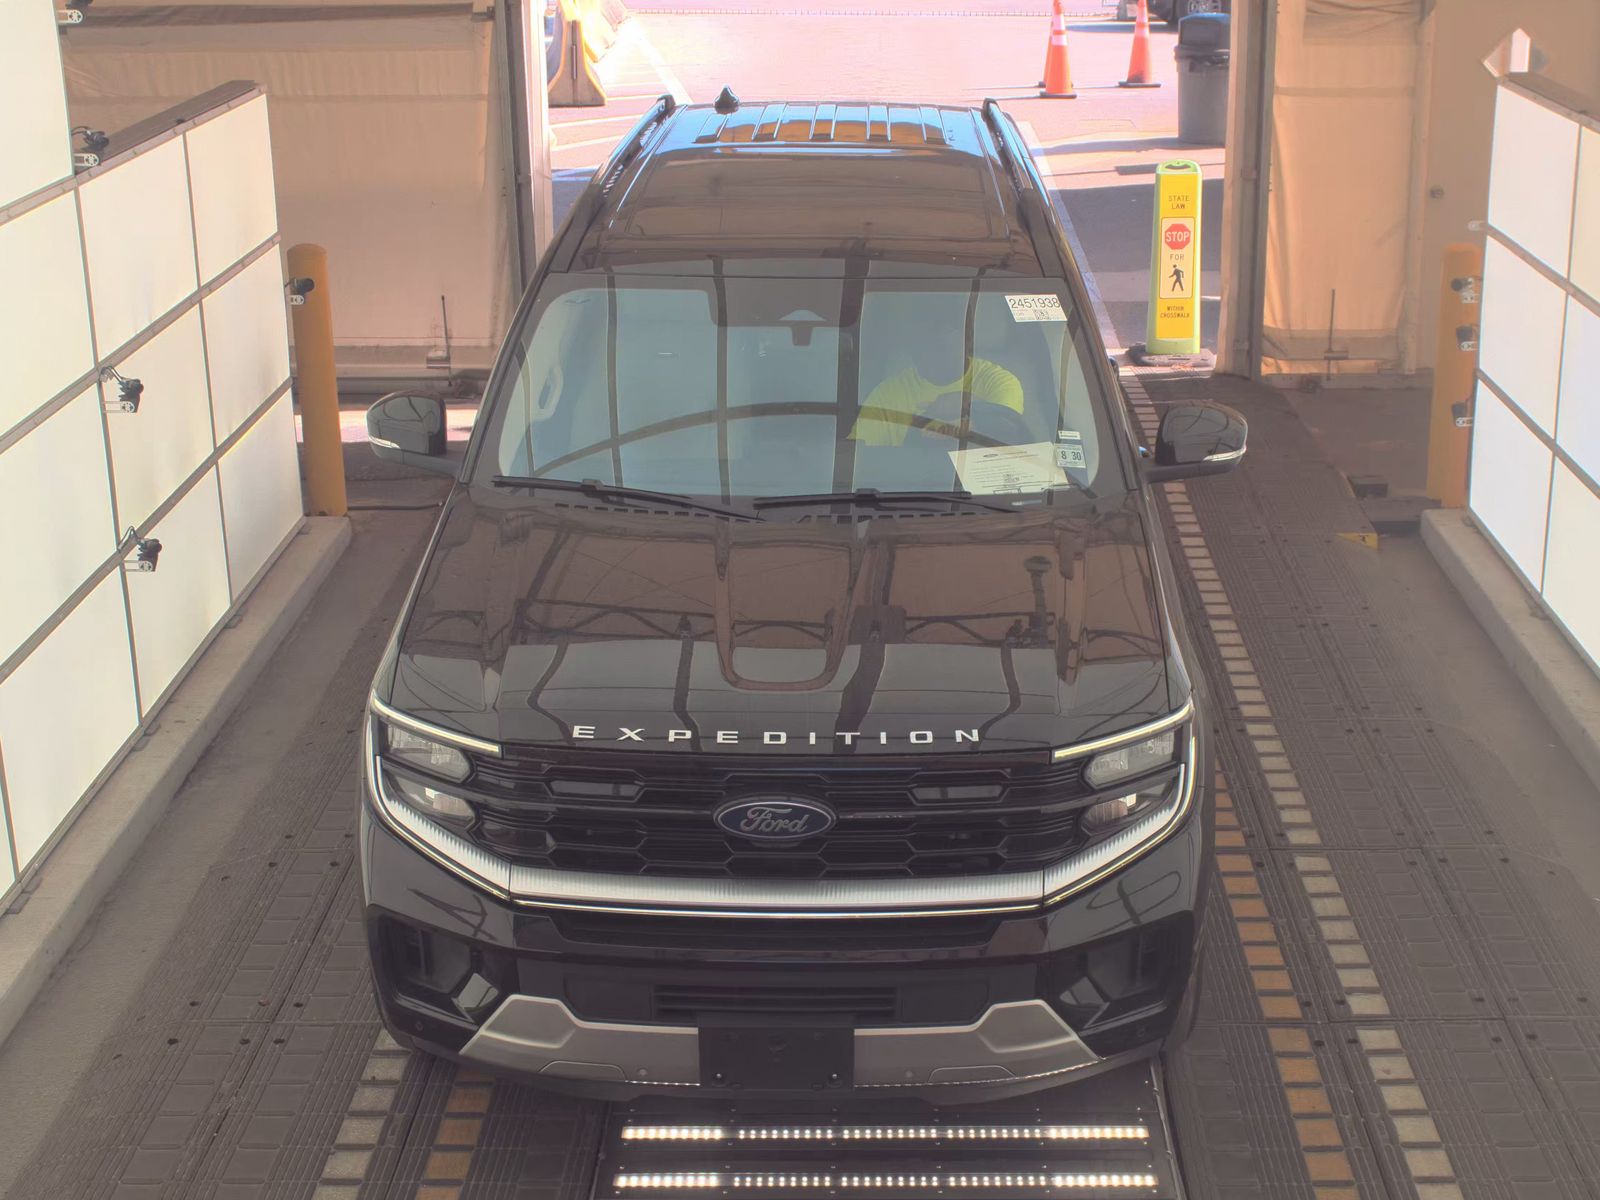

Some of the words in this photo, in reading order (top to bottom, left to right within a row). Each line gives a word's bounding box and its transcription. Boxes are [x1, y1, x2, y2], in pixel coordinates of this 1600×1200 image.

[1166, 231, 1190, 242] STOP
[1009, 297, 1061, 309] 2451938
[1061, 450, 1067, 460] 8
[1071, 451, 1082, 461] 30
[572, 725, 980, 745] EXPEDITION
[740, 806, 808, 834] Ford
